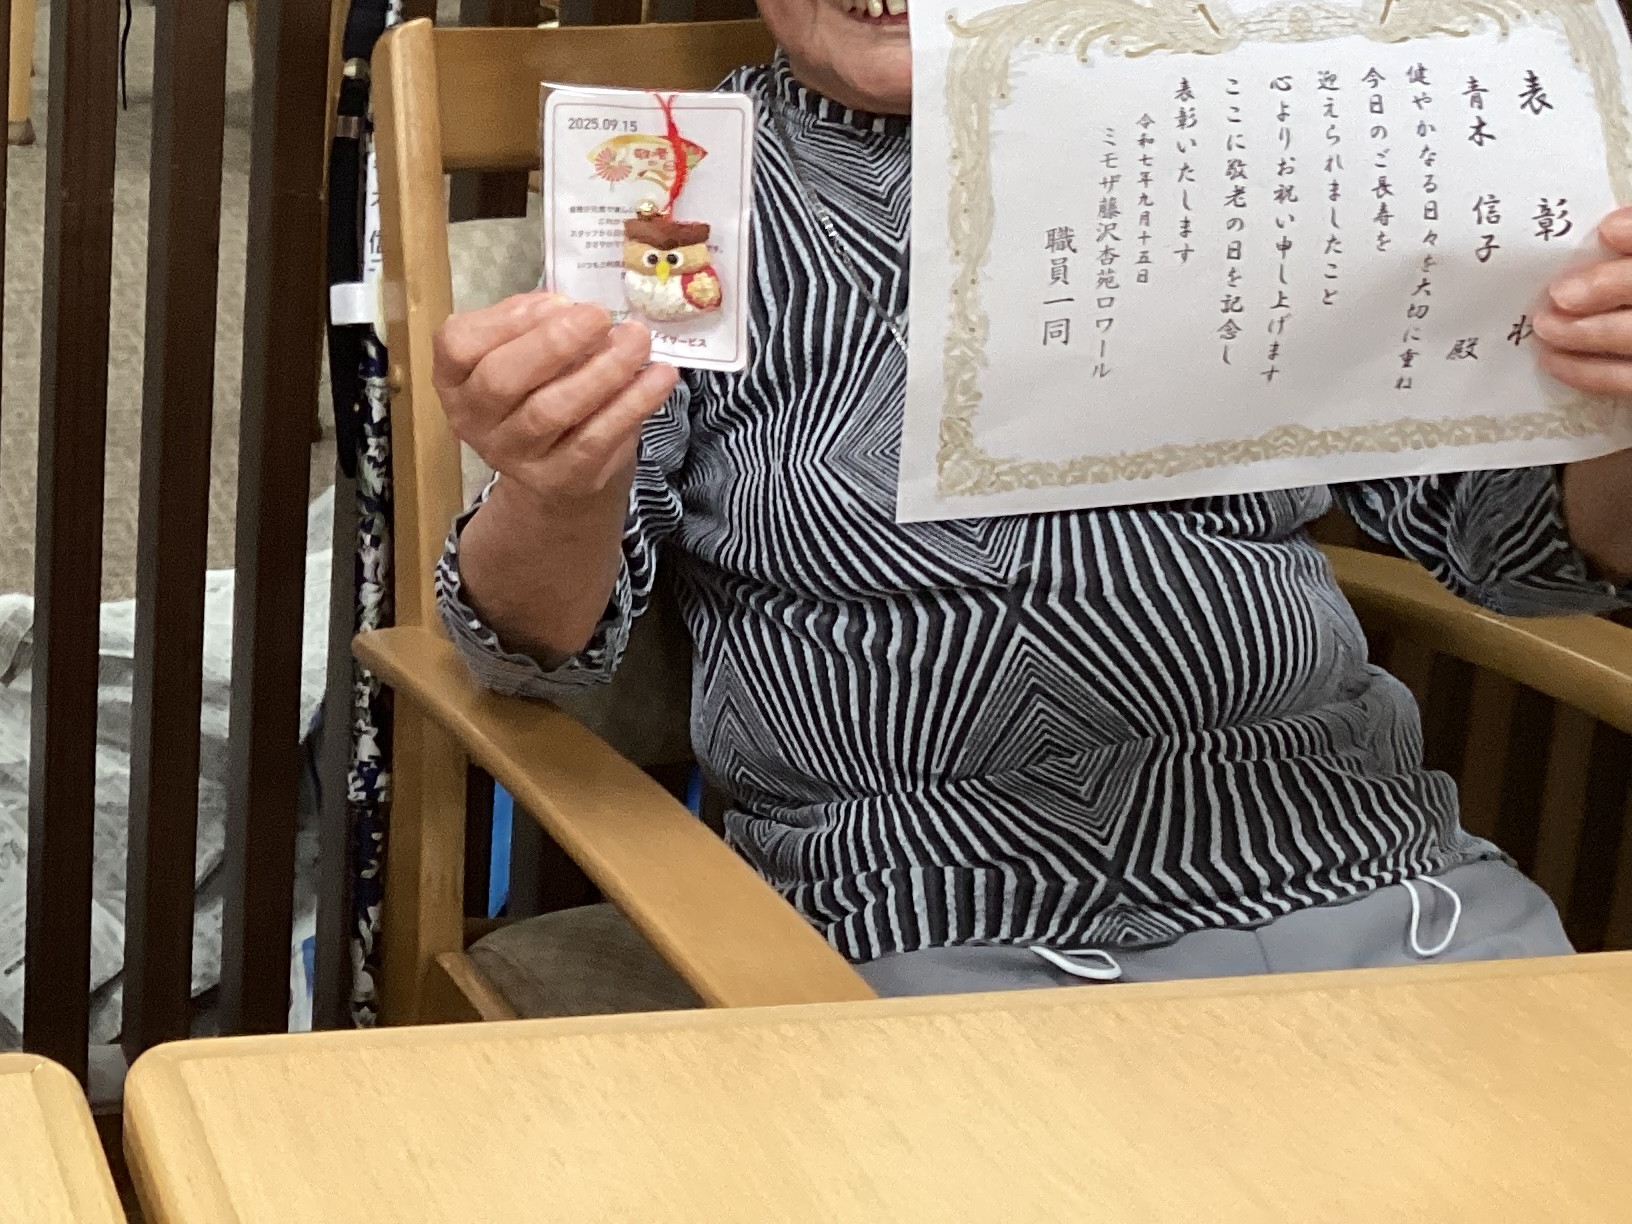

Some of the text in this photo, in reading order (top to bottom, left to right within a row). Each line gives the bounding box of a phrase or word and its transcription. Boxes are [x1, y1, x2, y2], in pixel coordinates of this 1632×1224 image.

[567, 117, 639, 133] 2025.09.15
[1134, 112, 1156, 284] 令和七年九月十五日
[1172, 76, 1198, 264] 表彰いたします
[1216, 77, 1249, 365] ここに敬老の日を記念し
[1260, 75, 1299, 383] 心よりお祝い申し上げます
[1316, 69, 1345, 306] 迎えられましたこと
[1360, 66, 1395, 253] 今日のご長寿を
[1393, 62, 1439, 391] 健やかなる日々を大切に重ね
[1445, 75, 1502, 361] 青木 信子 殿
[1042, 225, 1078, 347] 職員一同
[1092, 127, 1123, 379] ミモザ藤沢杏苑ロワール
